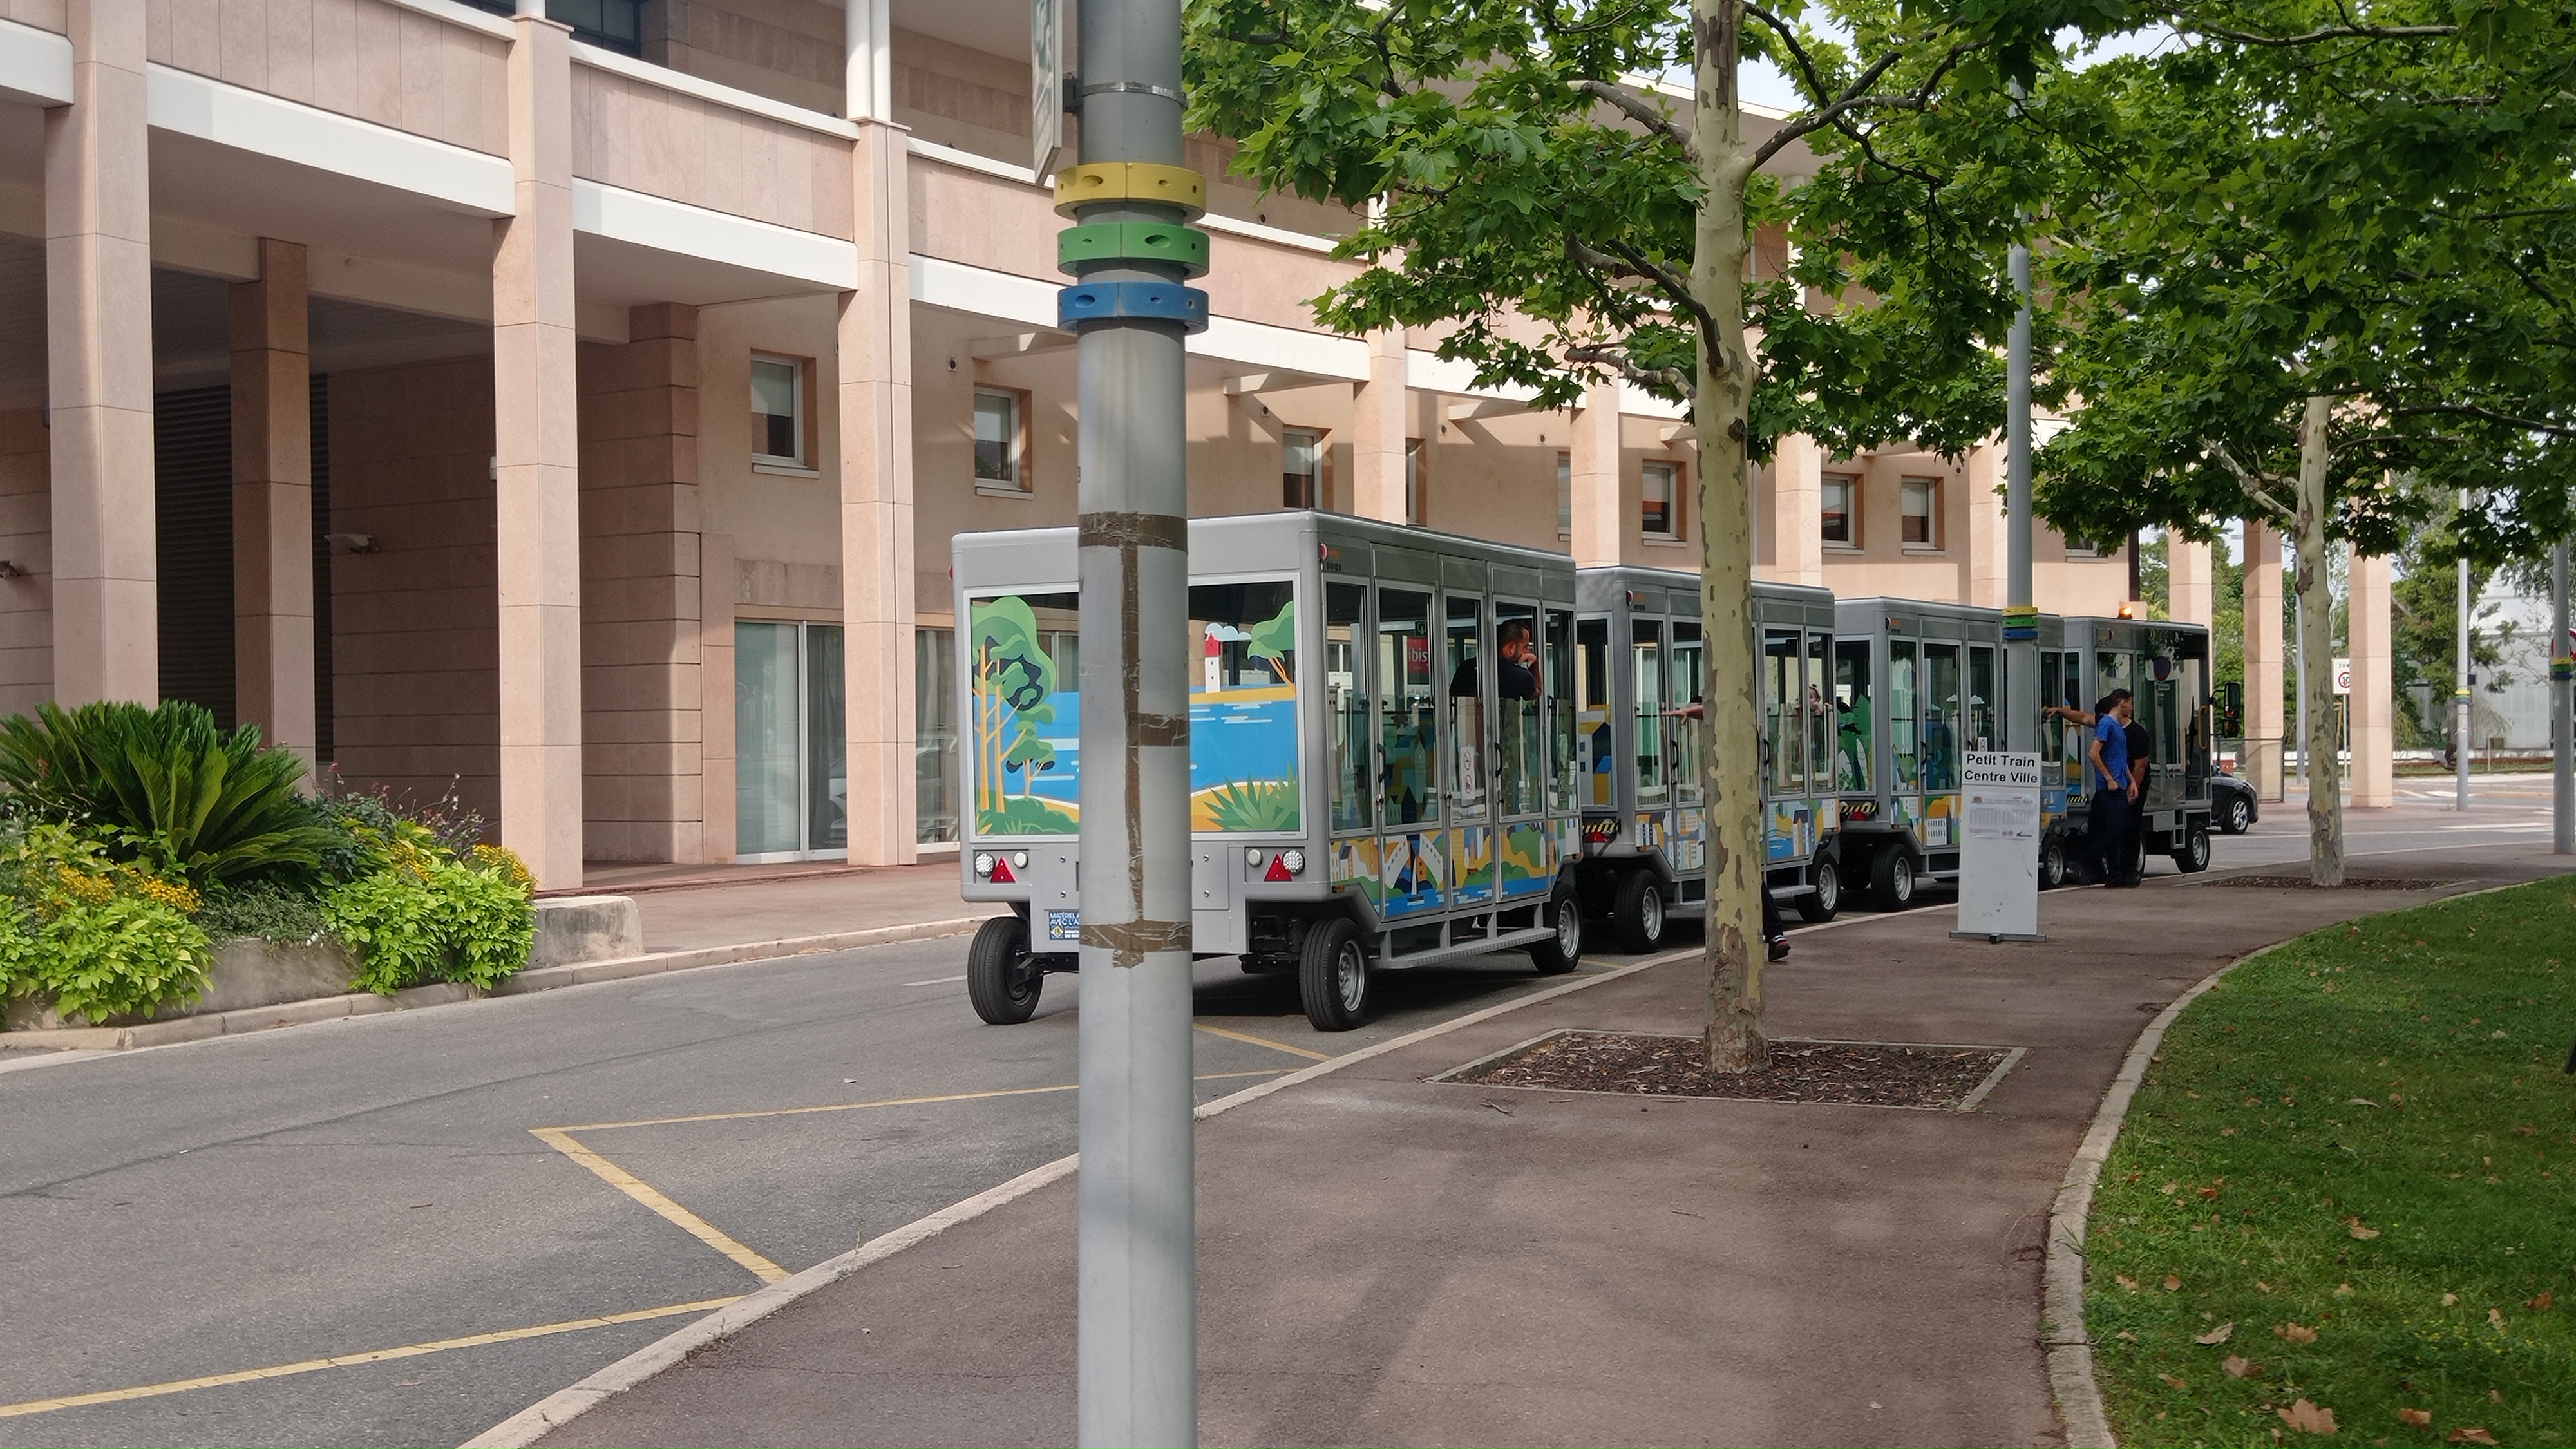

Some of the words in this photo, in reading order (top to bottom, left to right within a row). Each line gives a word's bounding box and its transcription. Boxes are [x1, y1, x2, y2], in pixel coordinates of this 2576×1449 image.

[1408, 647, 1428, 663] ibis
[1967, 753, 1996, 766] Petit
[2000, 755, 2035, 767] Train
[1965, 770, 2006, 782] Centre
[2011, 772, 2038, 783] Ville
